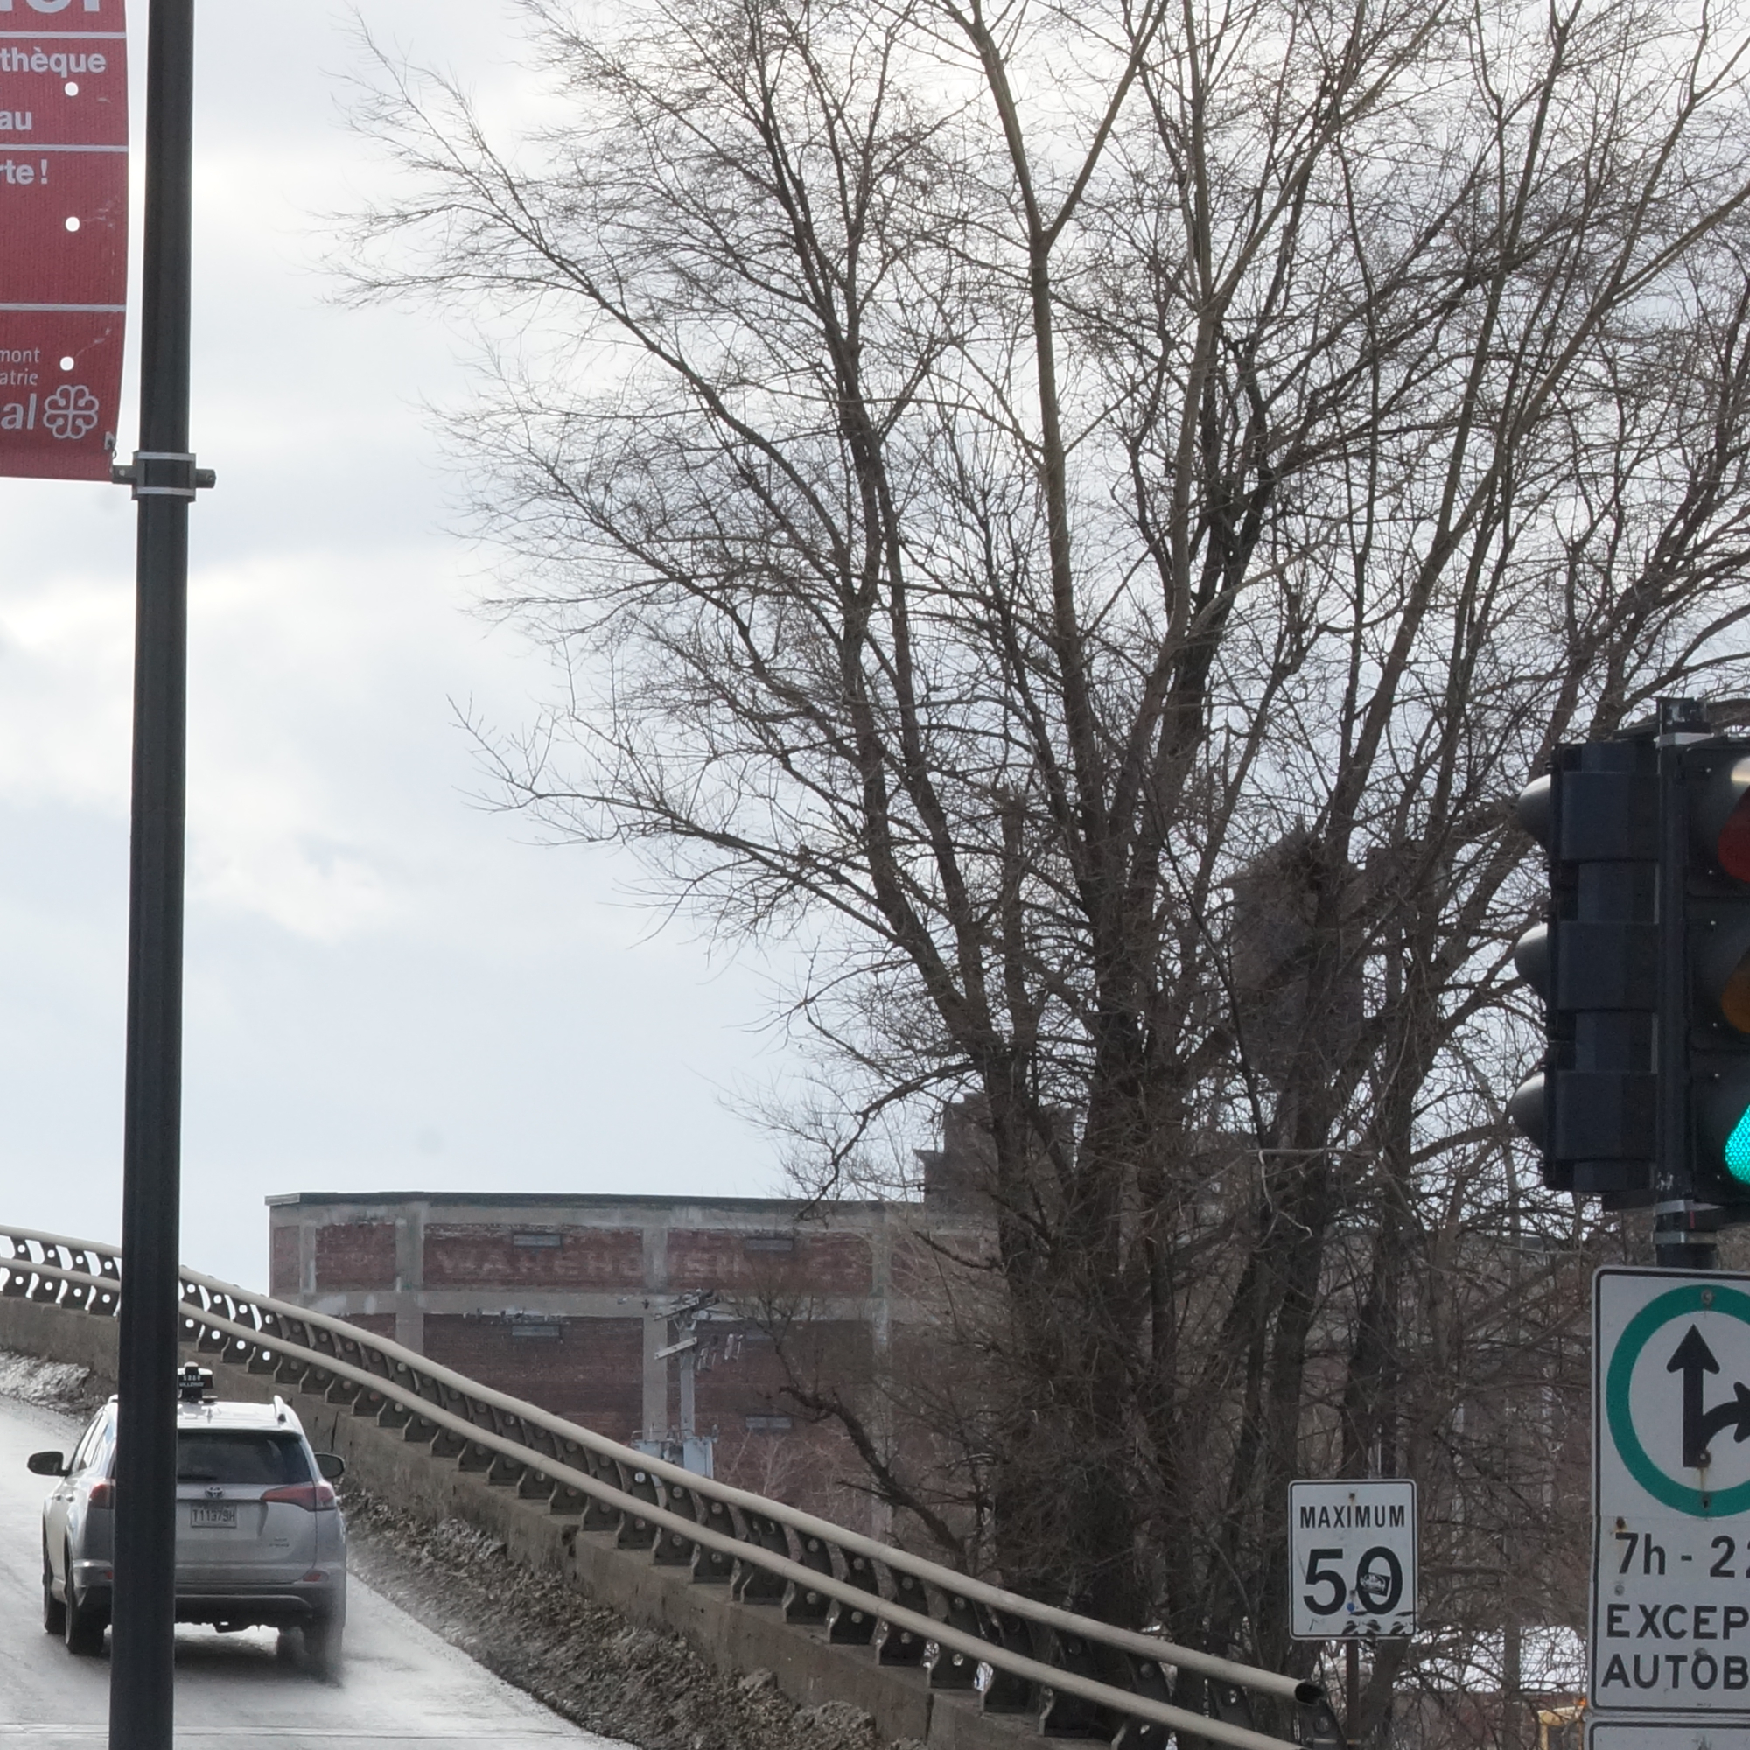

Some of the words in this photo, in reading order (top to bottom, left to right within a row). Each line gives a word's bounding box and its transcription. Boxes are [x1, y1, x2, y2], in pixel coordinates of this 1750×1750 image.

[1301, 1505, 1405, 1530] MAXIMUM
[1615, 1532, 1666, 1576] 7h
[1710, 1535, 1750, 1579] 2
[1304, 1546, 1404, 1616] 50
[1601, 1654, 1750, 1691] AUTOB
